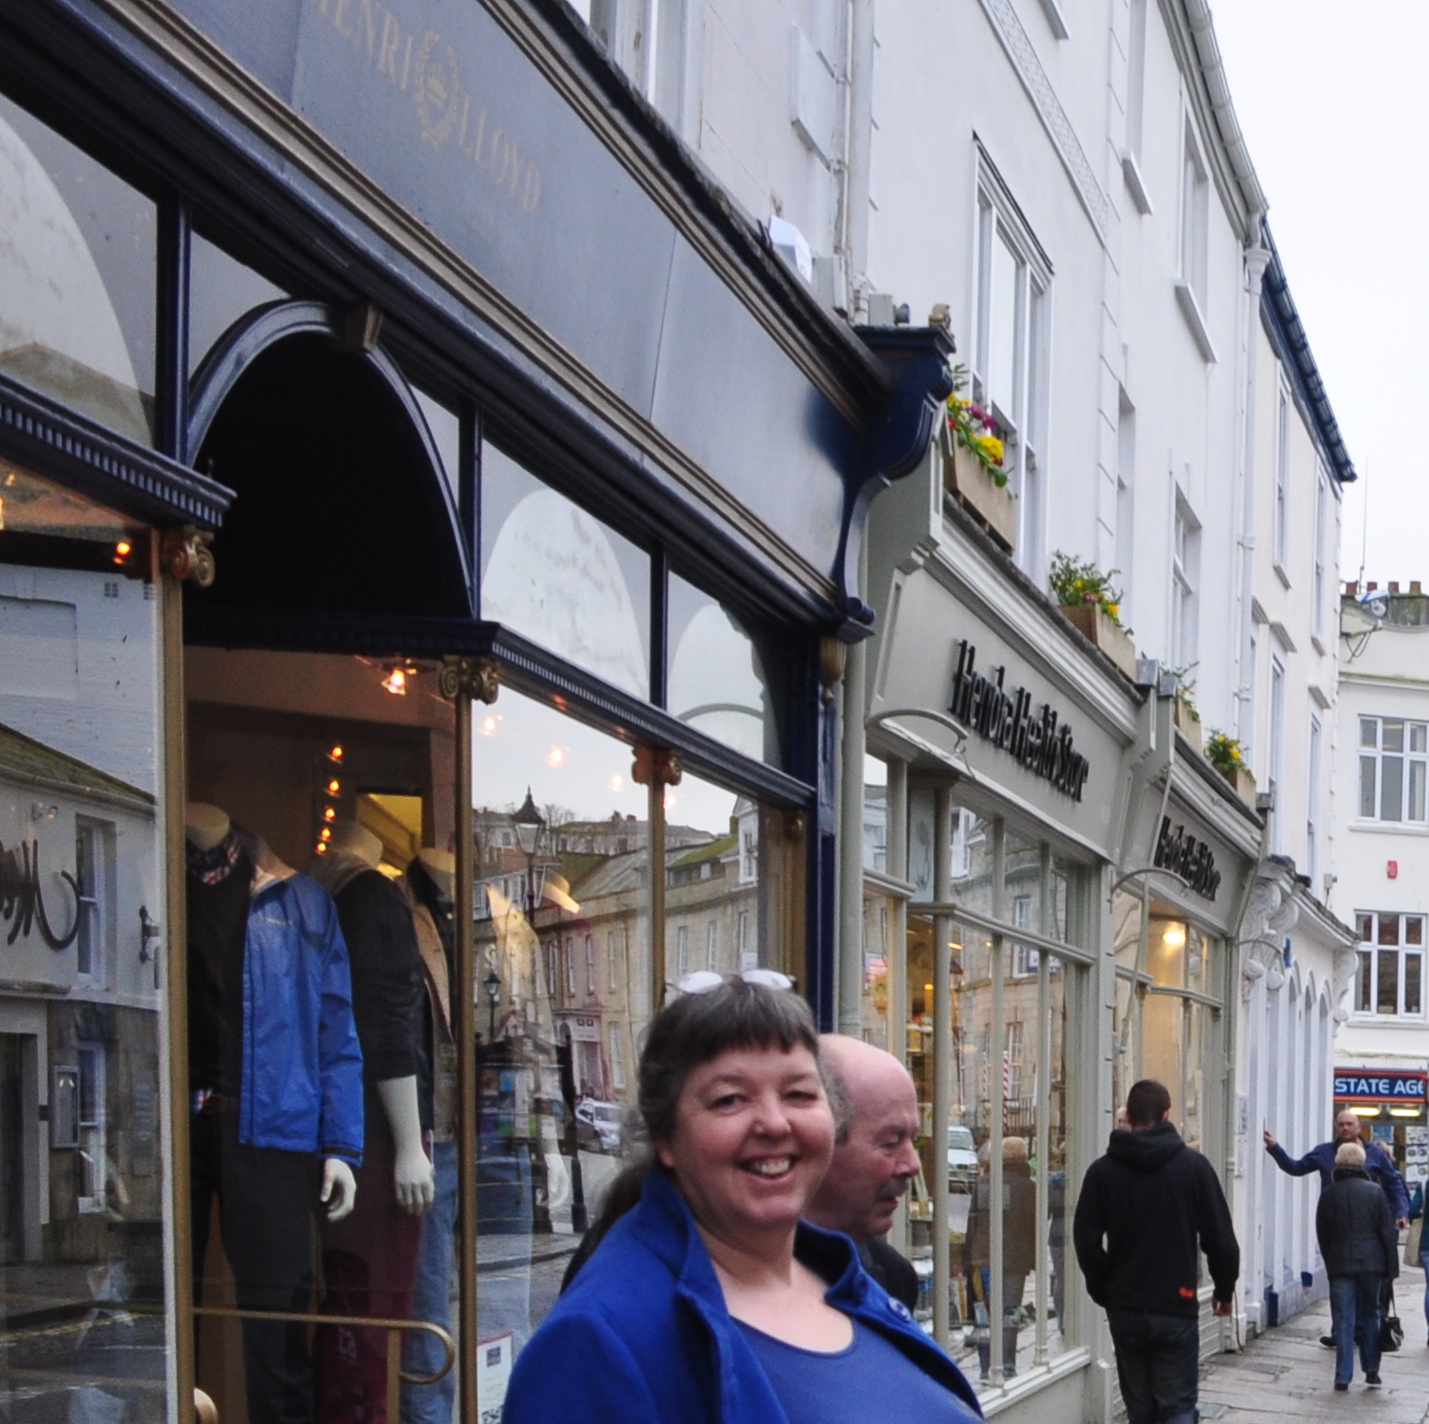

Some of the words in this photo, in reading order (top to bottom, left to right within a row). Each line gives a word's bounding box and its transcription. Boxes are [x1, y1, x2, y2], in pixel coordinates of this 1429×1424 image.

[316, 0, 414, 90] ENRI
[458, 92, 541, 214] LLOYD
[949, 640, 1015, 752] Hendra
[1334, 1078, 1390, 1094] STATE
